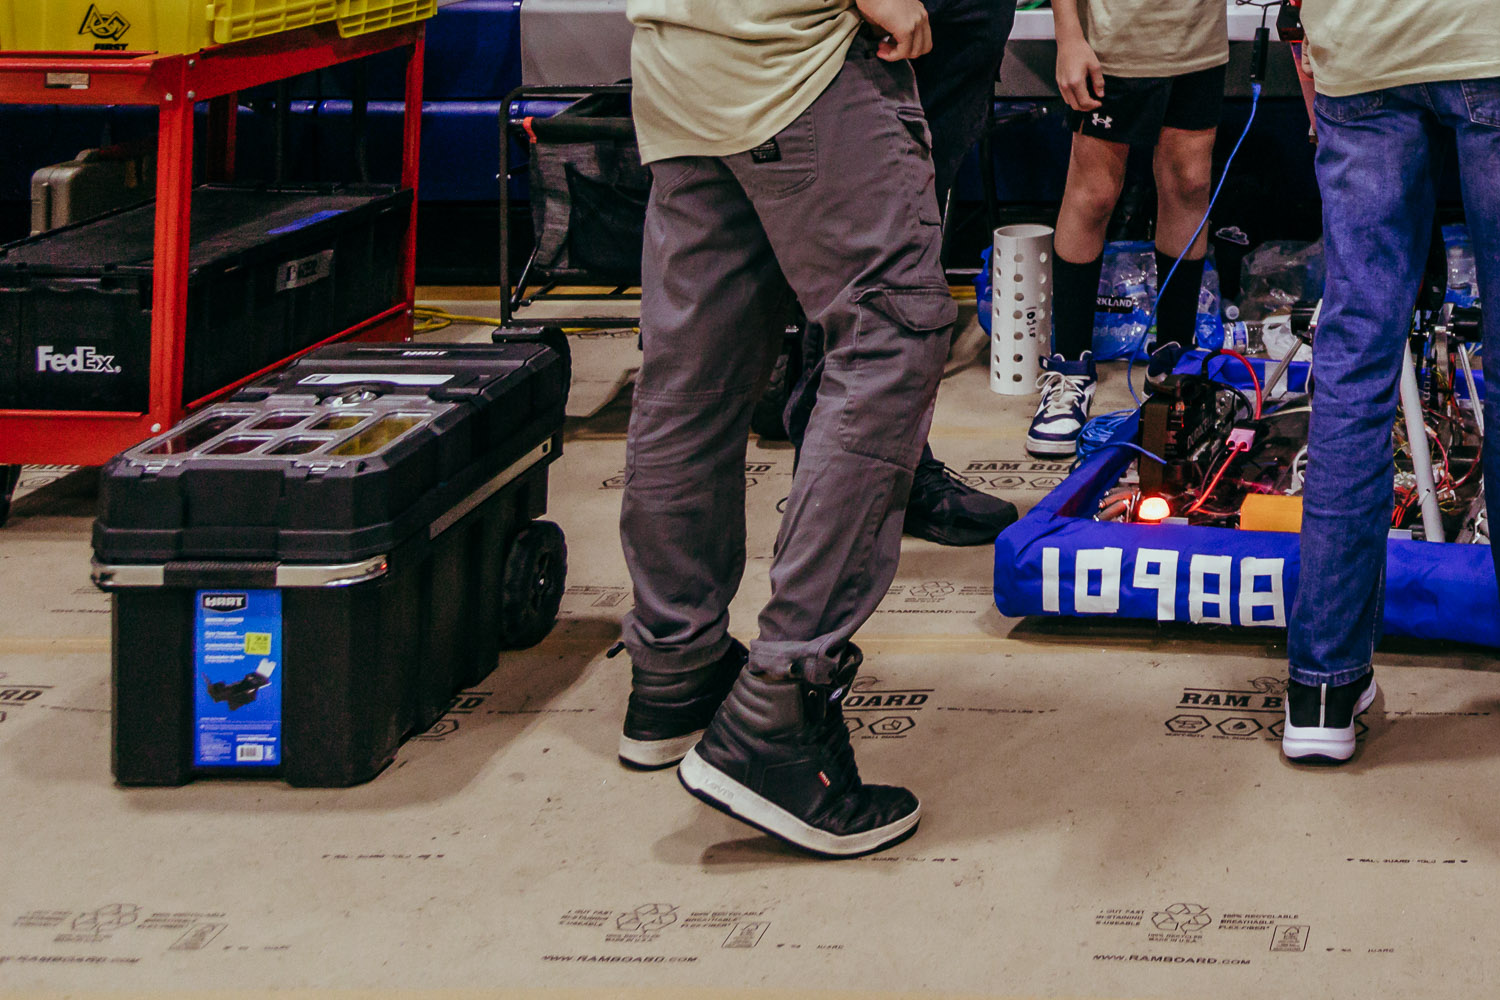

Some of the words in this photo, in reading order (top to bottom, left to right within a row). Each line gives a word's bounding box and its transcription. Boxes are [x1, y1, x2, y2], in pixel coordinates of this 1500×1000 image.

[965, 463, 1021, 471] RAM
[1042, 547, 1287, 627] 10988
[1179, 692, 1252, 708] RAM
[1093, 954, 1251, 965] WWW.RAMBOARD.COM
